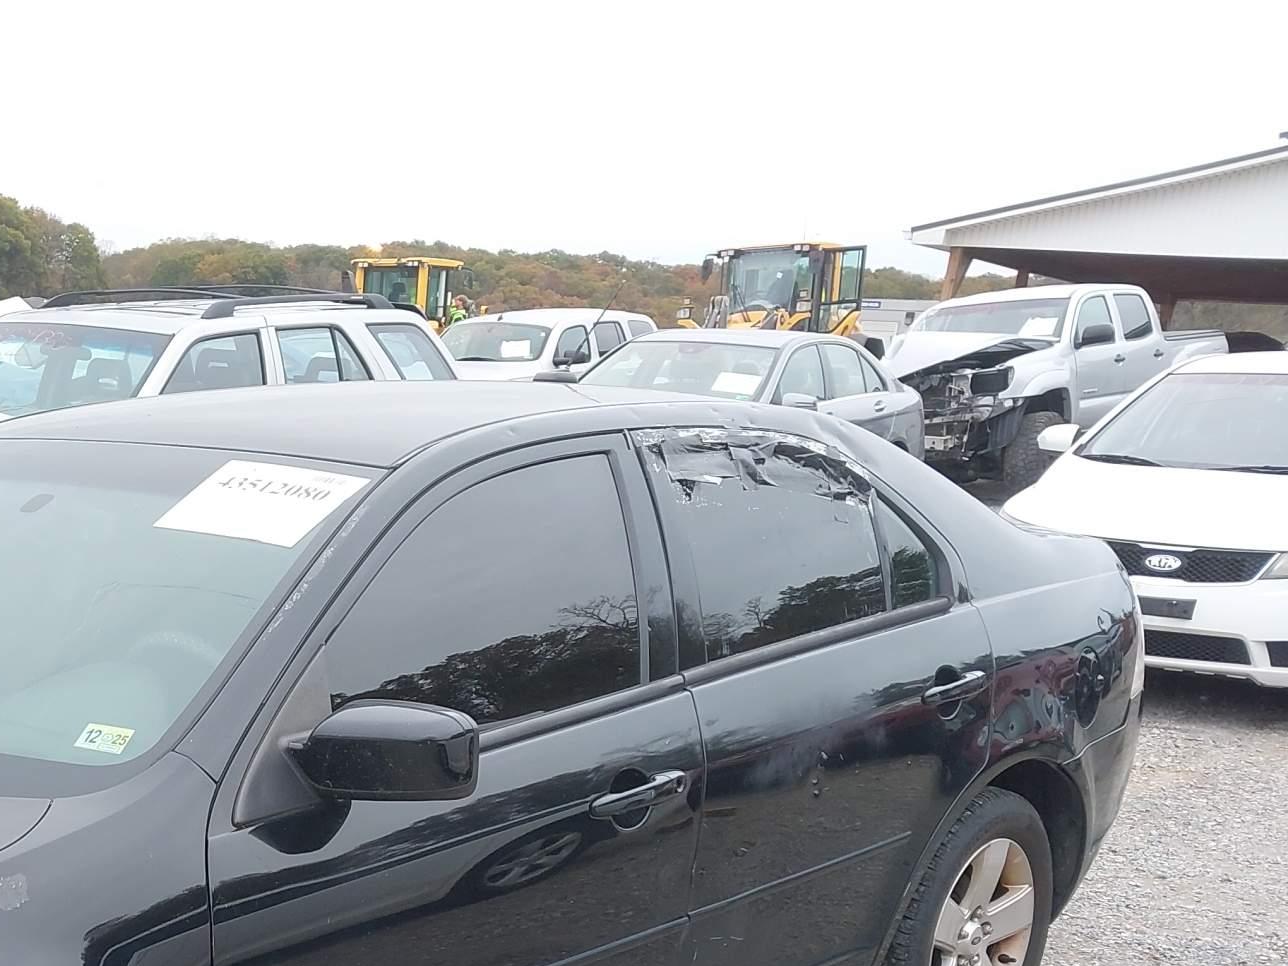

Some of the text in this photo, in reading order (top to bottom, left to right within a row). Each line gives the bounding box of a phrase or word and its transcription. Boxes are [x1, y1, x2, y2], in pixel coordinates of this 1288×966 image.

[218, 477, 331, 501] 43512080
[84, 728, 129, 746] 12 25
